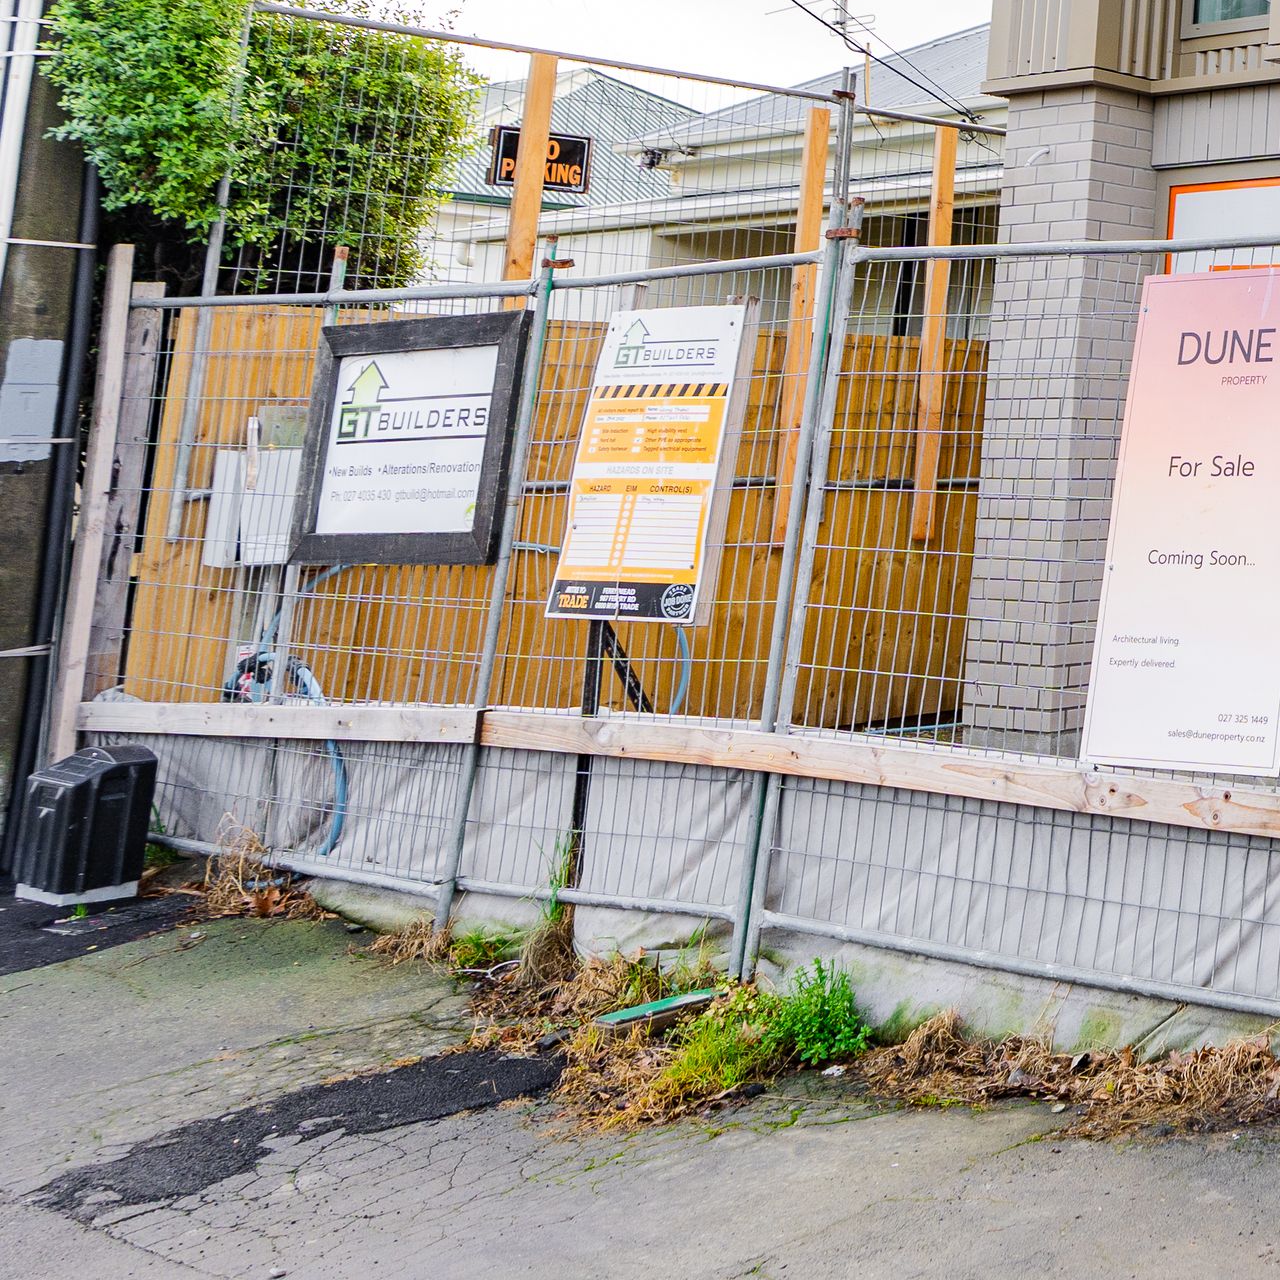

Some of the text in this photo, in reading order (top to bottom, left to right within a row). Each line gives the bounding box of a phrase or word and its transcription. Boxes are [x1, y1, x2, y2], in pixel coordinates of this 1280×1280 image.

[1177, 328, 1276, 365] DUNE
[615, 346, 716, 365] GT BUILDERS
[1221, 375, 1268, 386] PROPERTY
[338, 405, 488, 438] GT BUILDERS
[332, 466, 346, 477] New
[348, 465, 372, 477] Builds
[607, 466, 675, 475] HAZARDS ON SITE
[1168, 454, 1255, 477] For Sale
[650, 486, 693, 494] CONTROL(S)
[1148, 549, 1256, 569] Coming Soon...
[668, 585, 688, 596] TRADE
[558, 595, 589, 608] TRADE
[664, 593, 692, 607] JOB DONE
[1112, 634, 1158, 644] Architectural
[1109, 657, 1139, 667] Expertly
[1218, 713, 1269, 725] 027 325 1449
[1167, 729, 1266, 744] sales@duneproperty.co.nz
